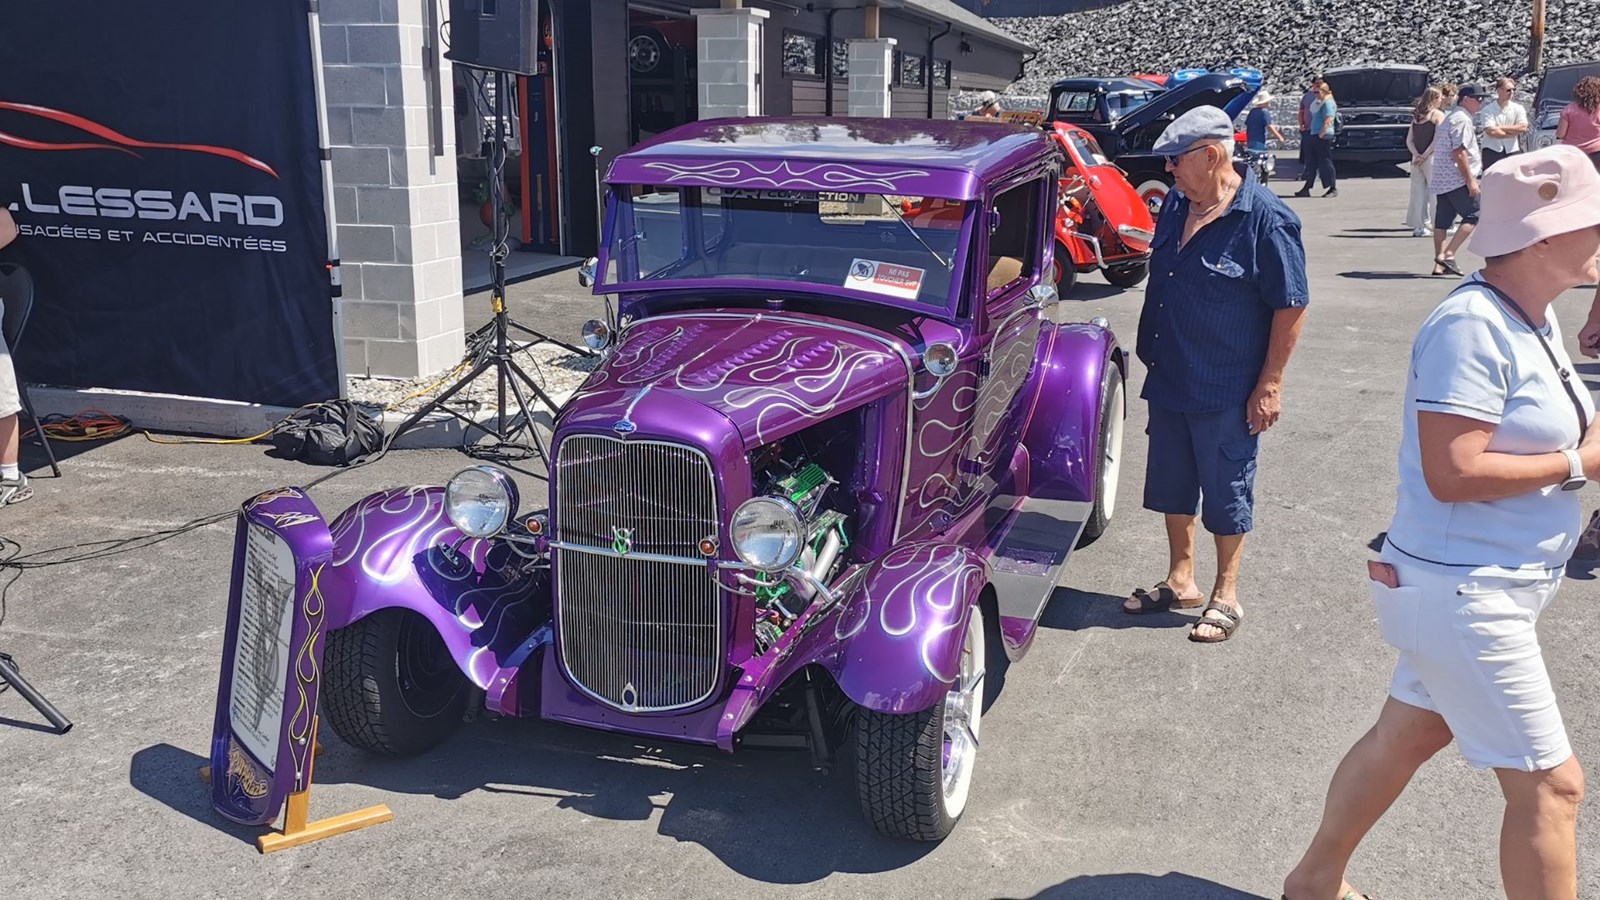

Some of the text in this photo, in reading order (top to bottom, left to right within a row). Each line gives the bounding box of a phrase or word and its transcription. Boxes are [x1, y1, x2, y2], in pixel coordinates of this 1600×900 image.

[107, 229, 134, 242] ET
[142, 231, 287, 253] ACCIDENTÉES
[897, 269, 910, 278] PAS
[877, 274, 918, 287] TOUCHER SVP
